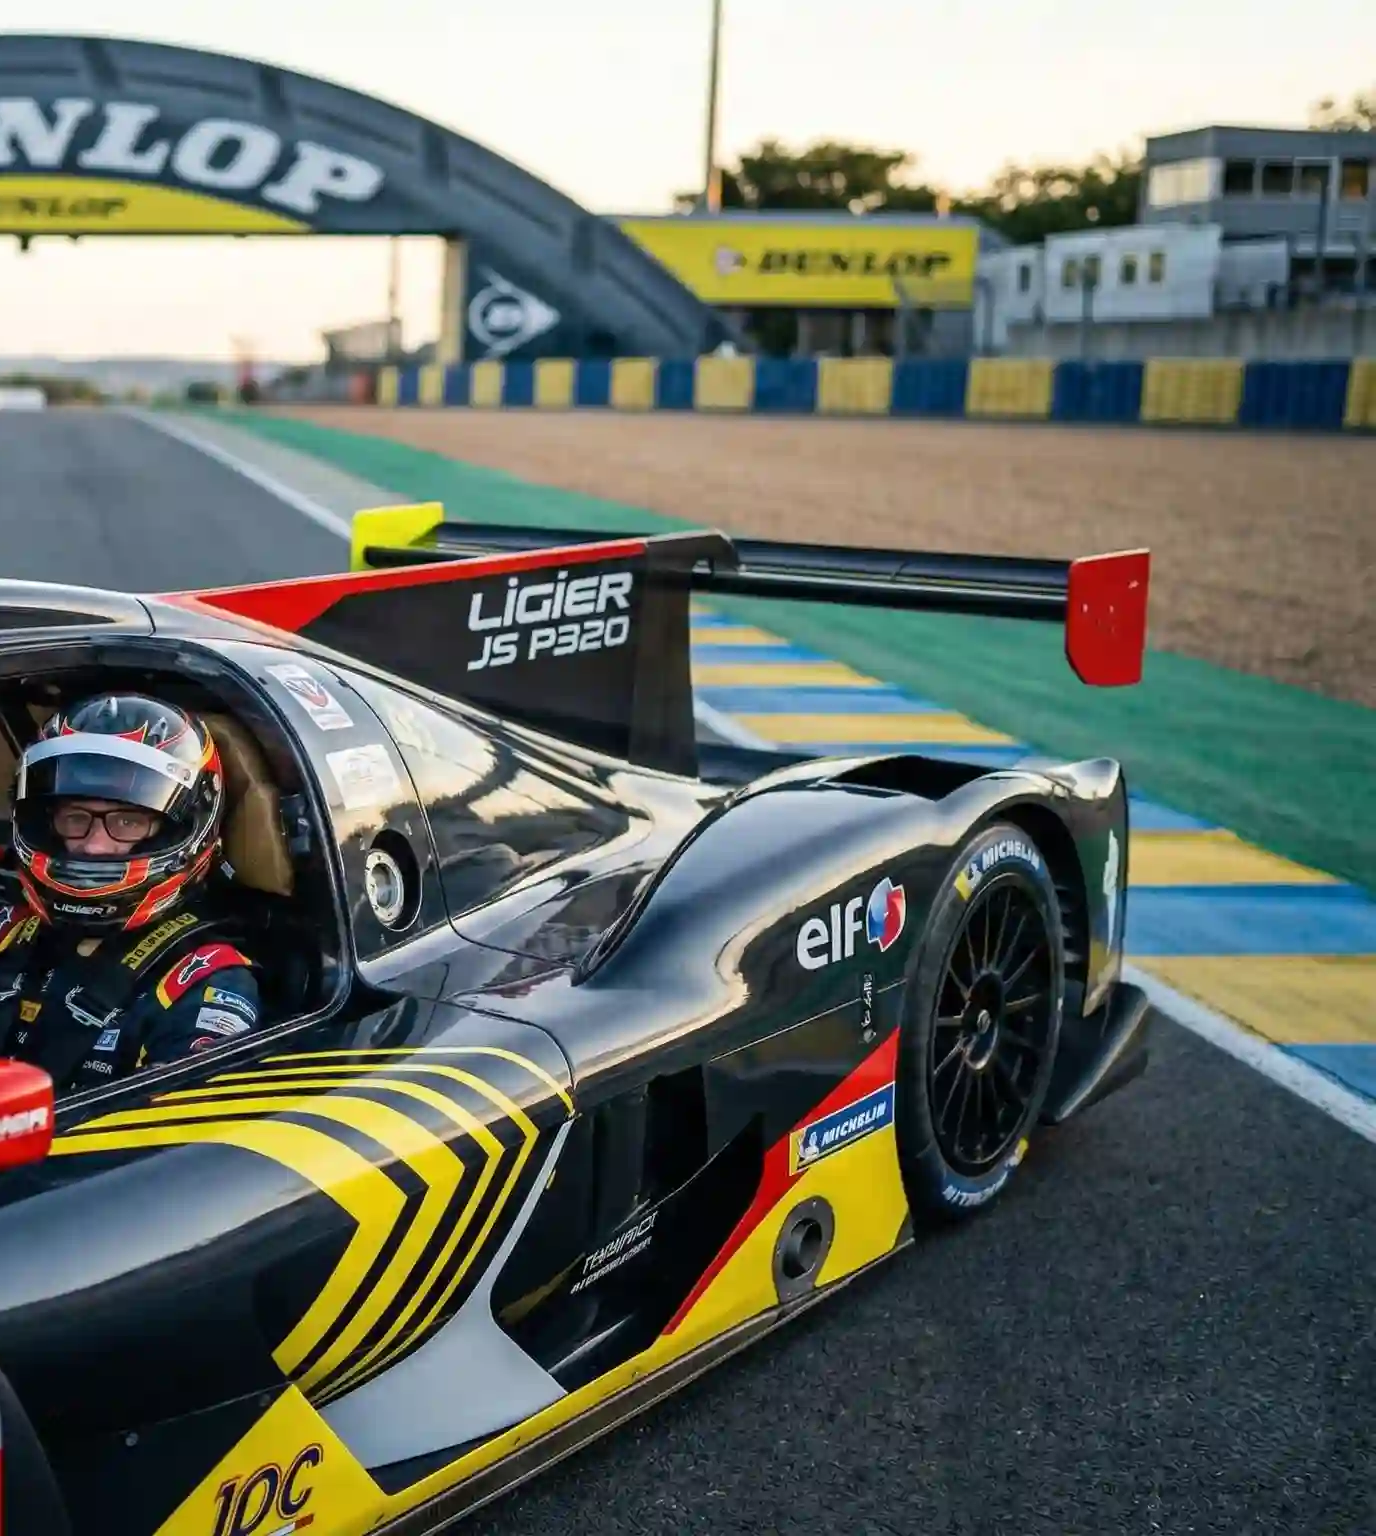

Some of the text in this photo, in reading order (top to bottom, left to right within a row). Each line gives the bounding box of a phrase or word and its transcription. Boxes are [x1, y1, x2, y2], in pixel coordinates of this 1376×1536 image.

[759, 249, 952, 277] DUNLOP
[467, 615, 630, 672] JS P320
[982, 839, 1040, 872] MICHELIN
[796, 896, 864, 970] elf
